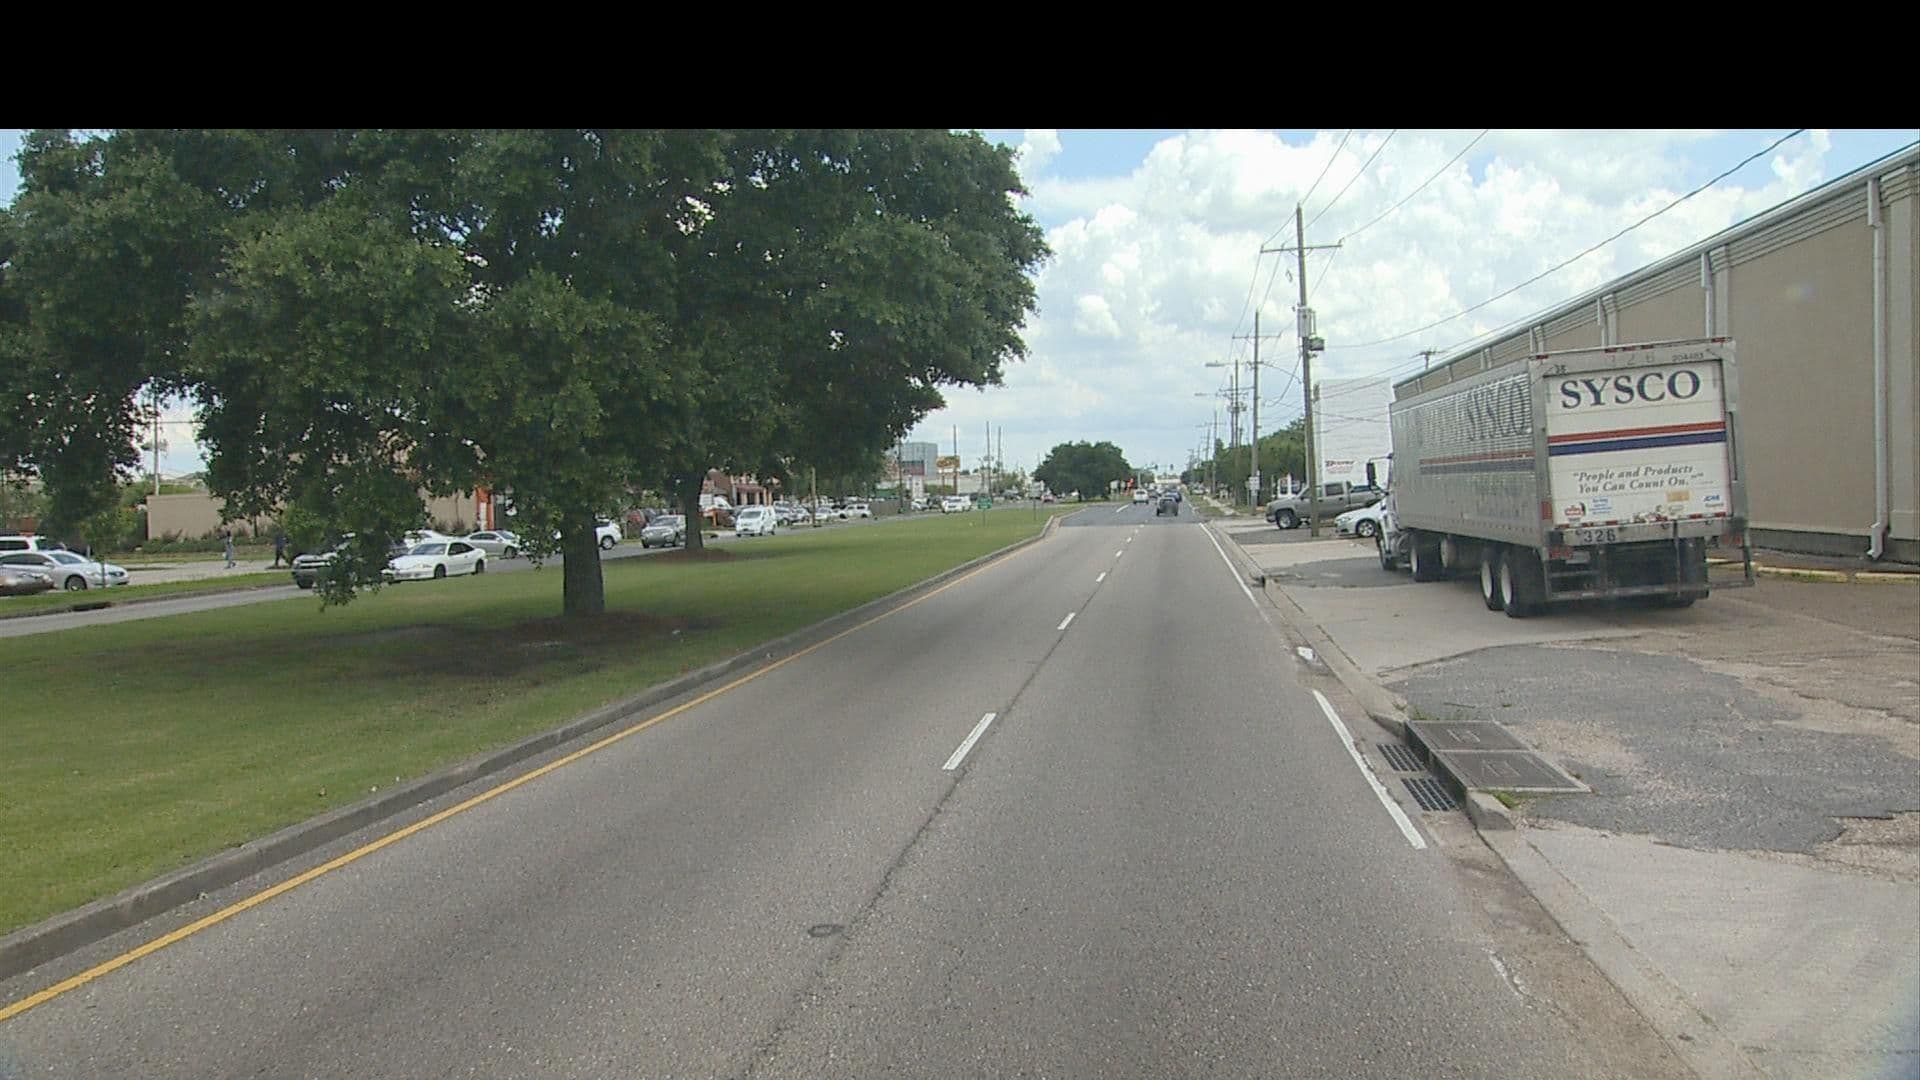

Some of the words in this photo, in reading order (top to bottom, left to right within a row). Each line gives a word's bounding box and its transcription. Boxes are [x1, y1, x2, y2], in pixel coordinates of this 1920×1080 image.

[1560, 370, 1701, 410] SYSCO
[1618, 467, 1641, 478] and
[1644, 464, 1694, 477] Products
[1578, 483, 1599, 494] You
[1603, 480, 1626, 491] Can
[1629, 478, 1665, 490] Count
[1583, 529, 1616, 543] 326
